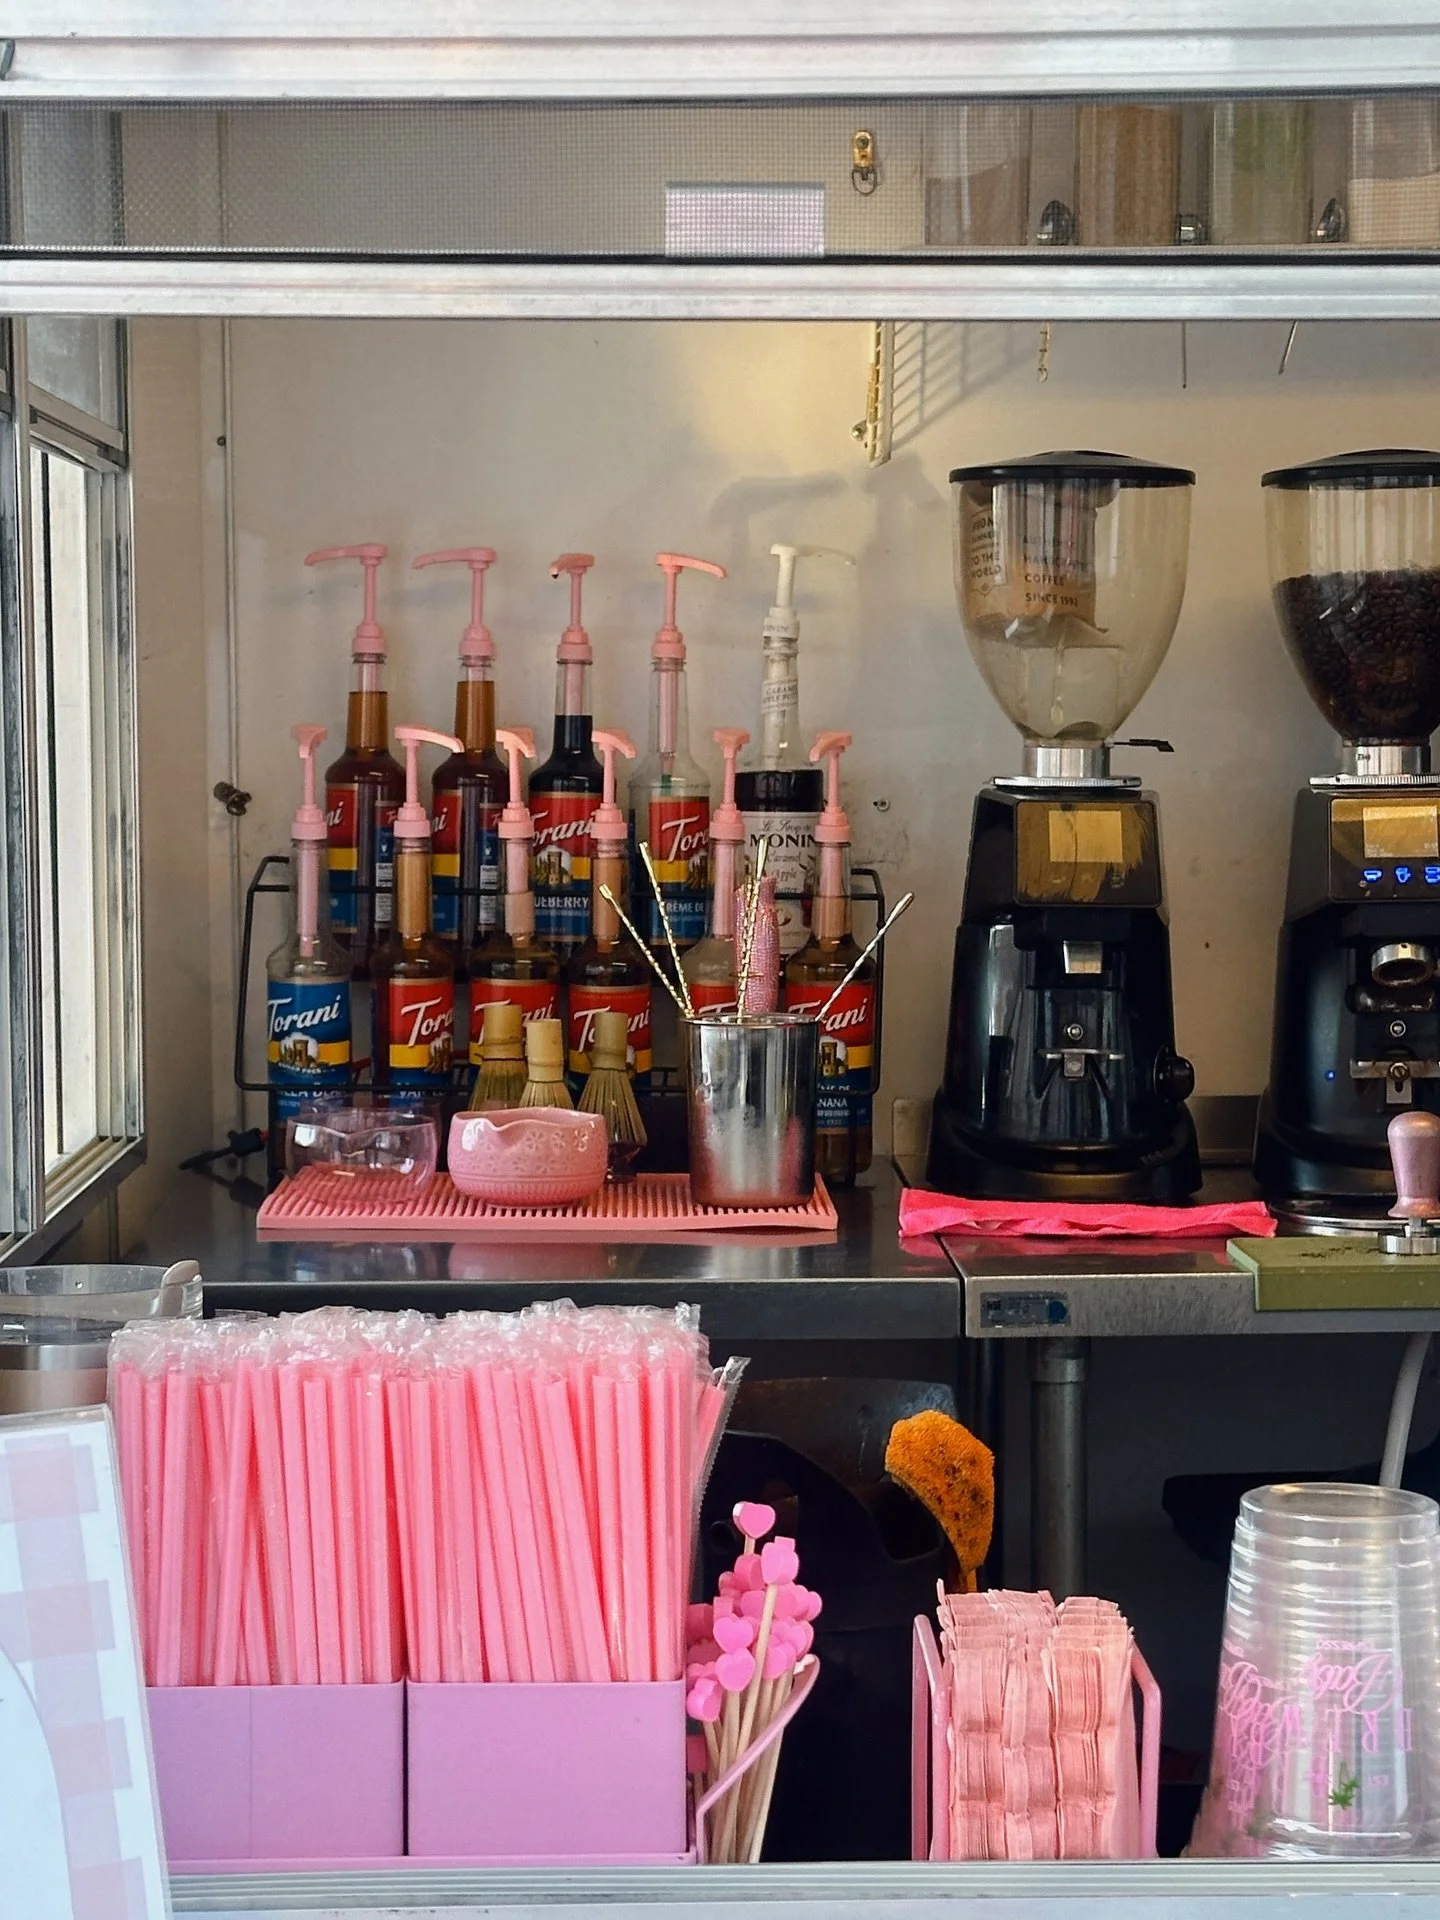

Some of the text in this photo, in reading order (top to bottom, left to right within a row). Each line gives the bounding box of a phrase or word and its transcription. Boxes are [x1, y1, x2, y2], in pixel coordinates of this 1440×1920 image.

[1025, 592, 1058, 604] SINCE
[750, 833, 815, 847] MONIN
[533, 896, 589, 908] UEBERRY
[267, 994, 341, 1041] Torani
[574, 1001, 650, 1053] Toni
[817, 1098, 848, 1108] NANA
